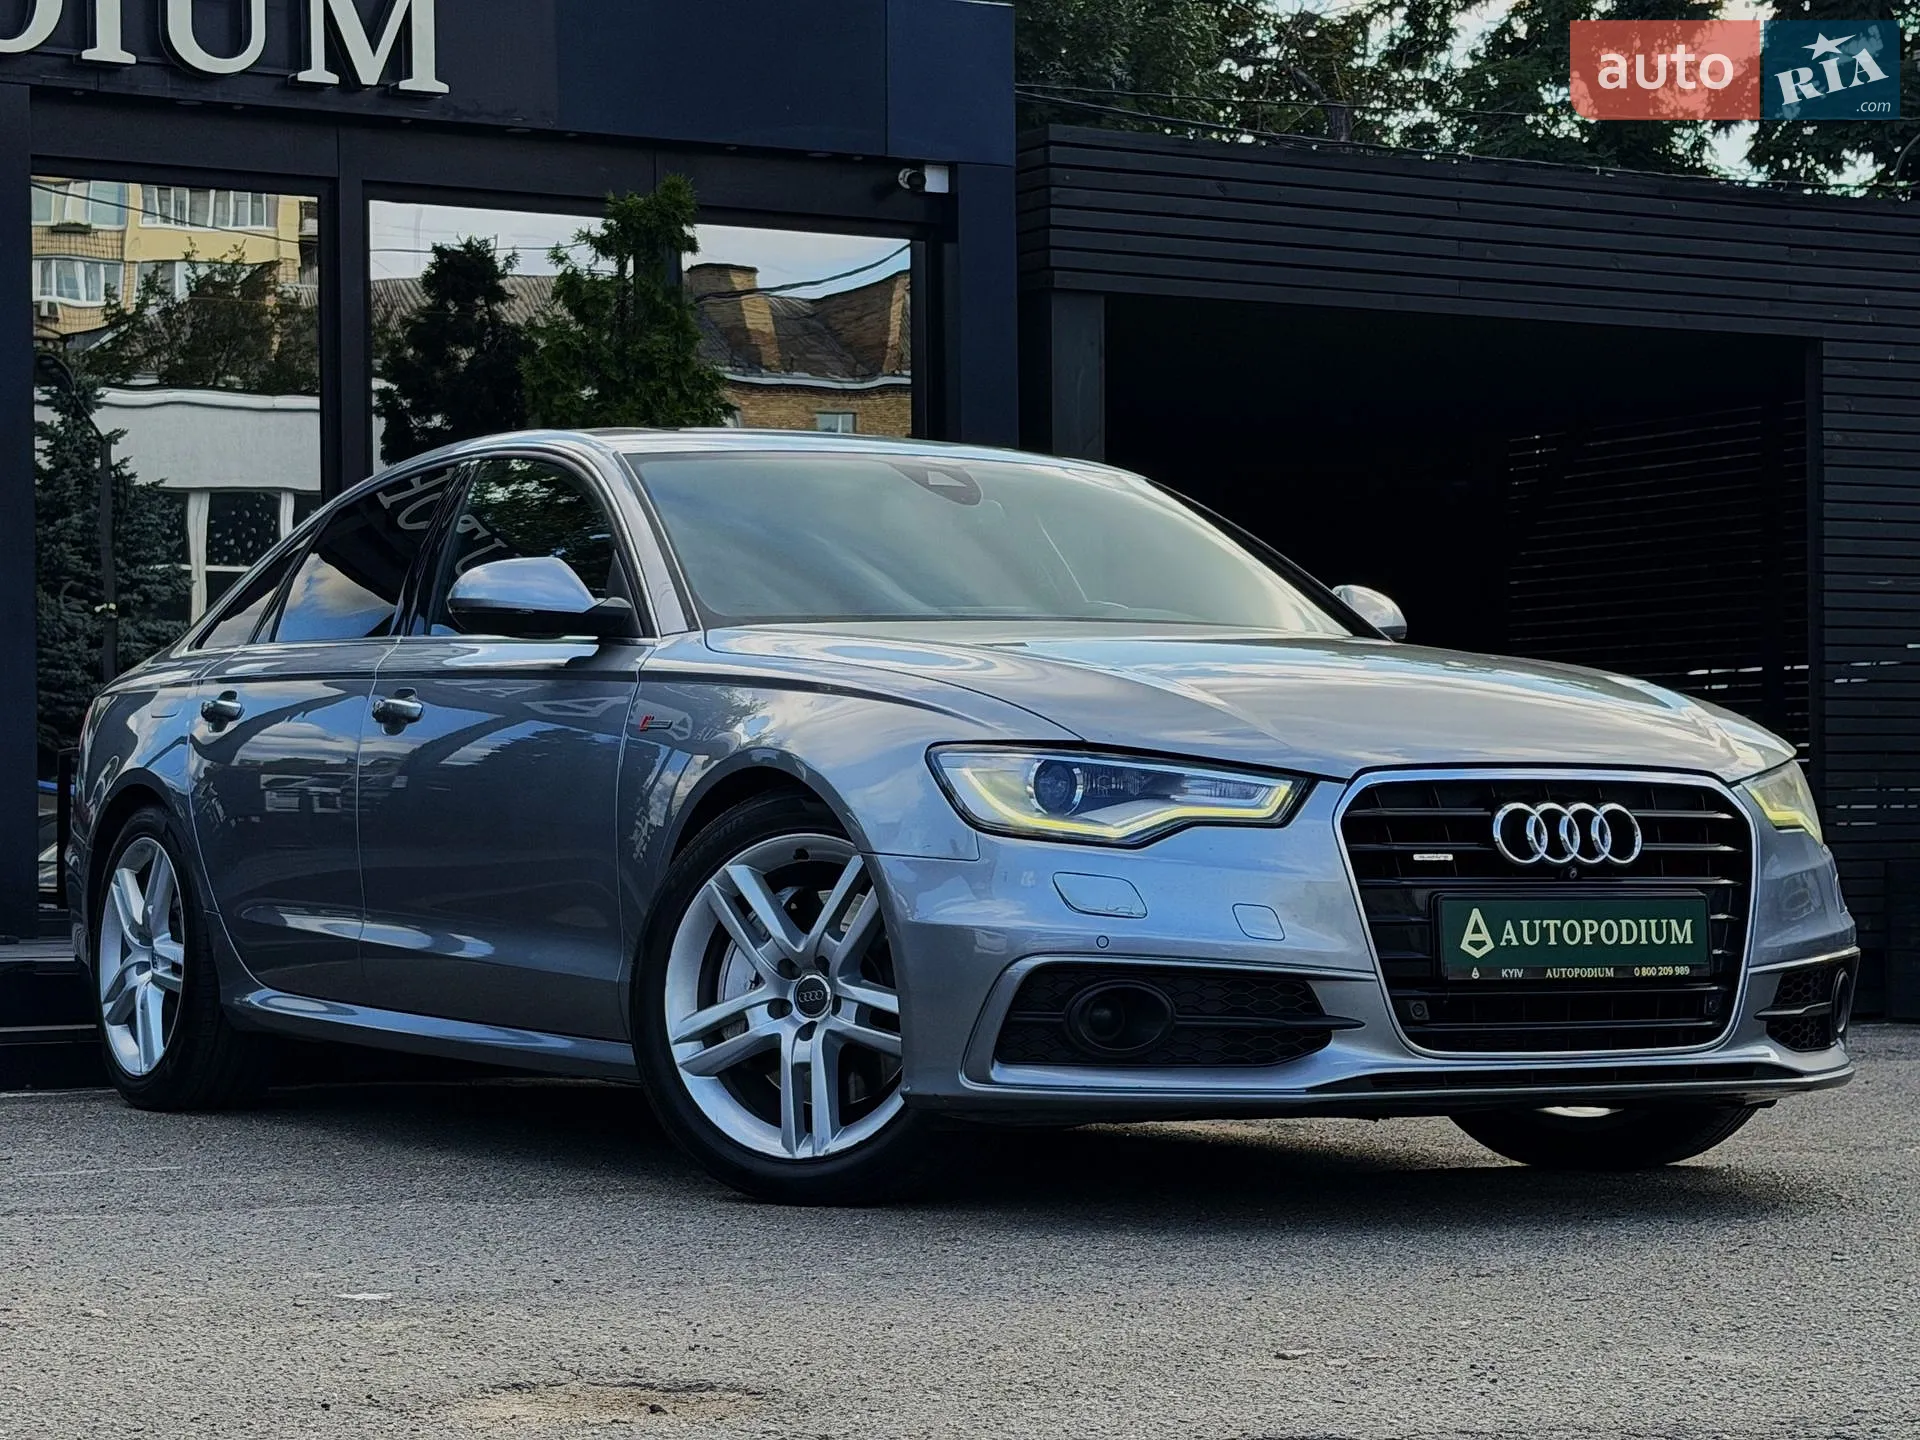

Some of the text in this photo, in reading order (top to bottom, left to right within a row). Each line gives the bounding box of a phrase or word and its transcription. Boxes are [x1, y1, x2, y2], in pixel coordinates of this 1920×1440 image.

[1500, 919, 1694, 947] AUTOPODIUM
[1501, 968, 1524, 979] KYIV
[1545, 967, 1614, 979] AUTOPODIUM
